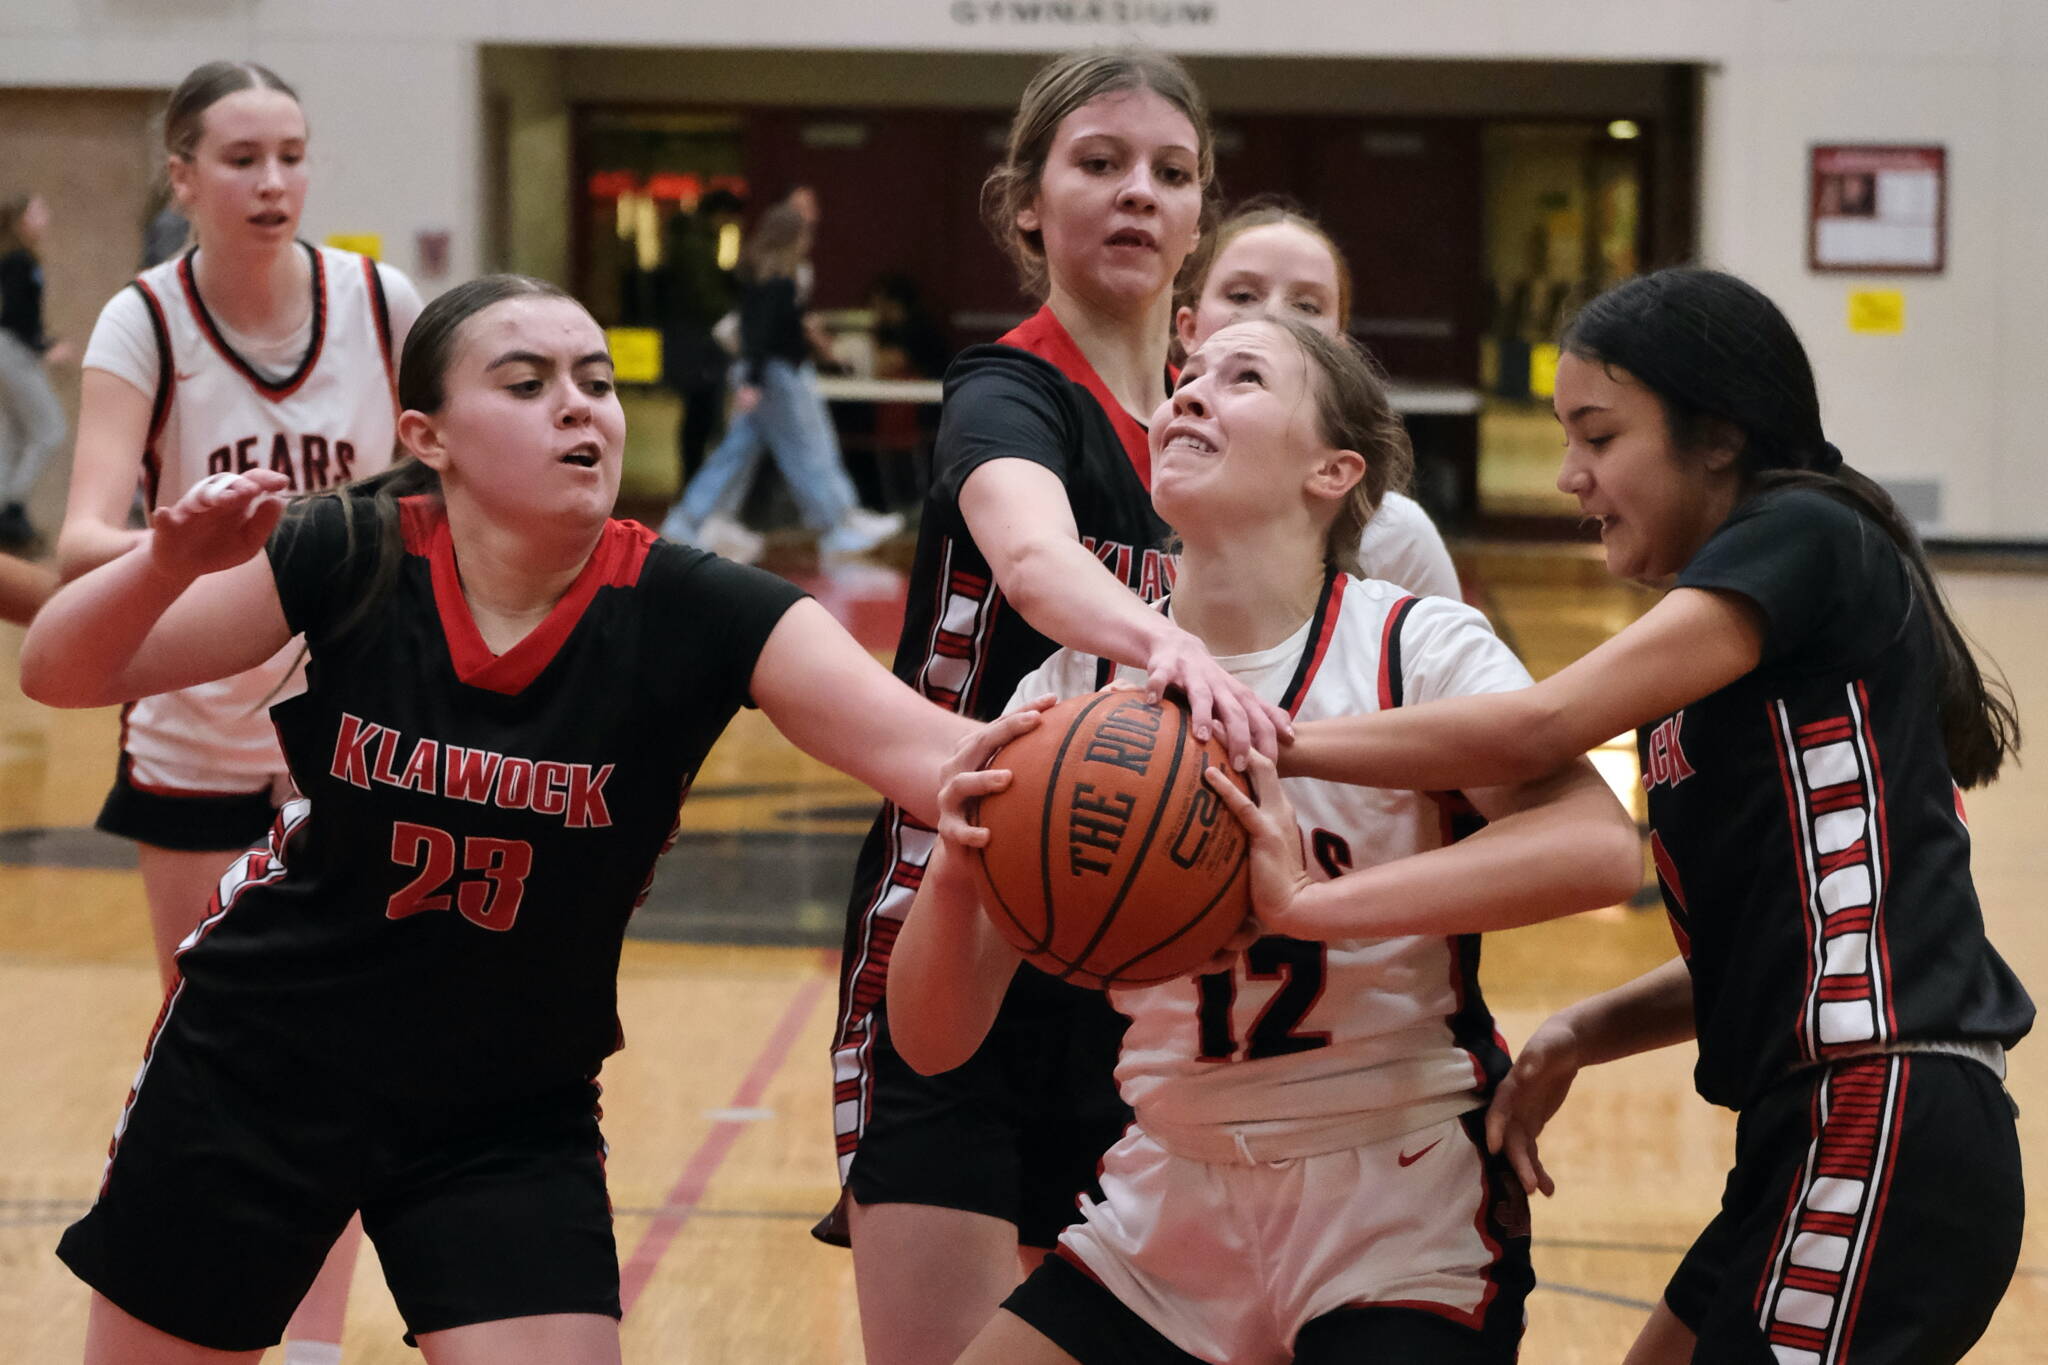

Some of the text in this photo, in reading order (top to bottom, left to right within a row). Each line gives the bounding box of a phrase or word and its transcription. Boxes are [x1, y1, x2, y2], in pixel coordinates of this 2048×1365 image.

[950, 0, 1217, 25] GYMNASIUM
[330, 711, 615, 828] KLAWOCK
[385, 821, 533, 932] 23
[1069, 782, 1136, 877] THE
[1192, 934, 1332, 1063] 12
